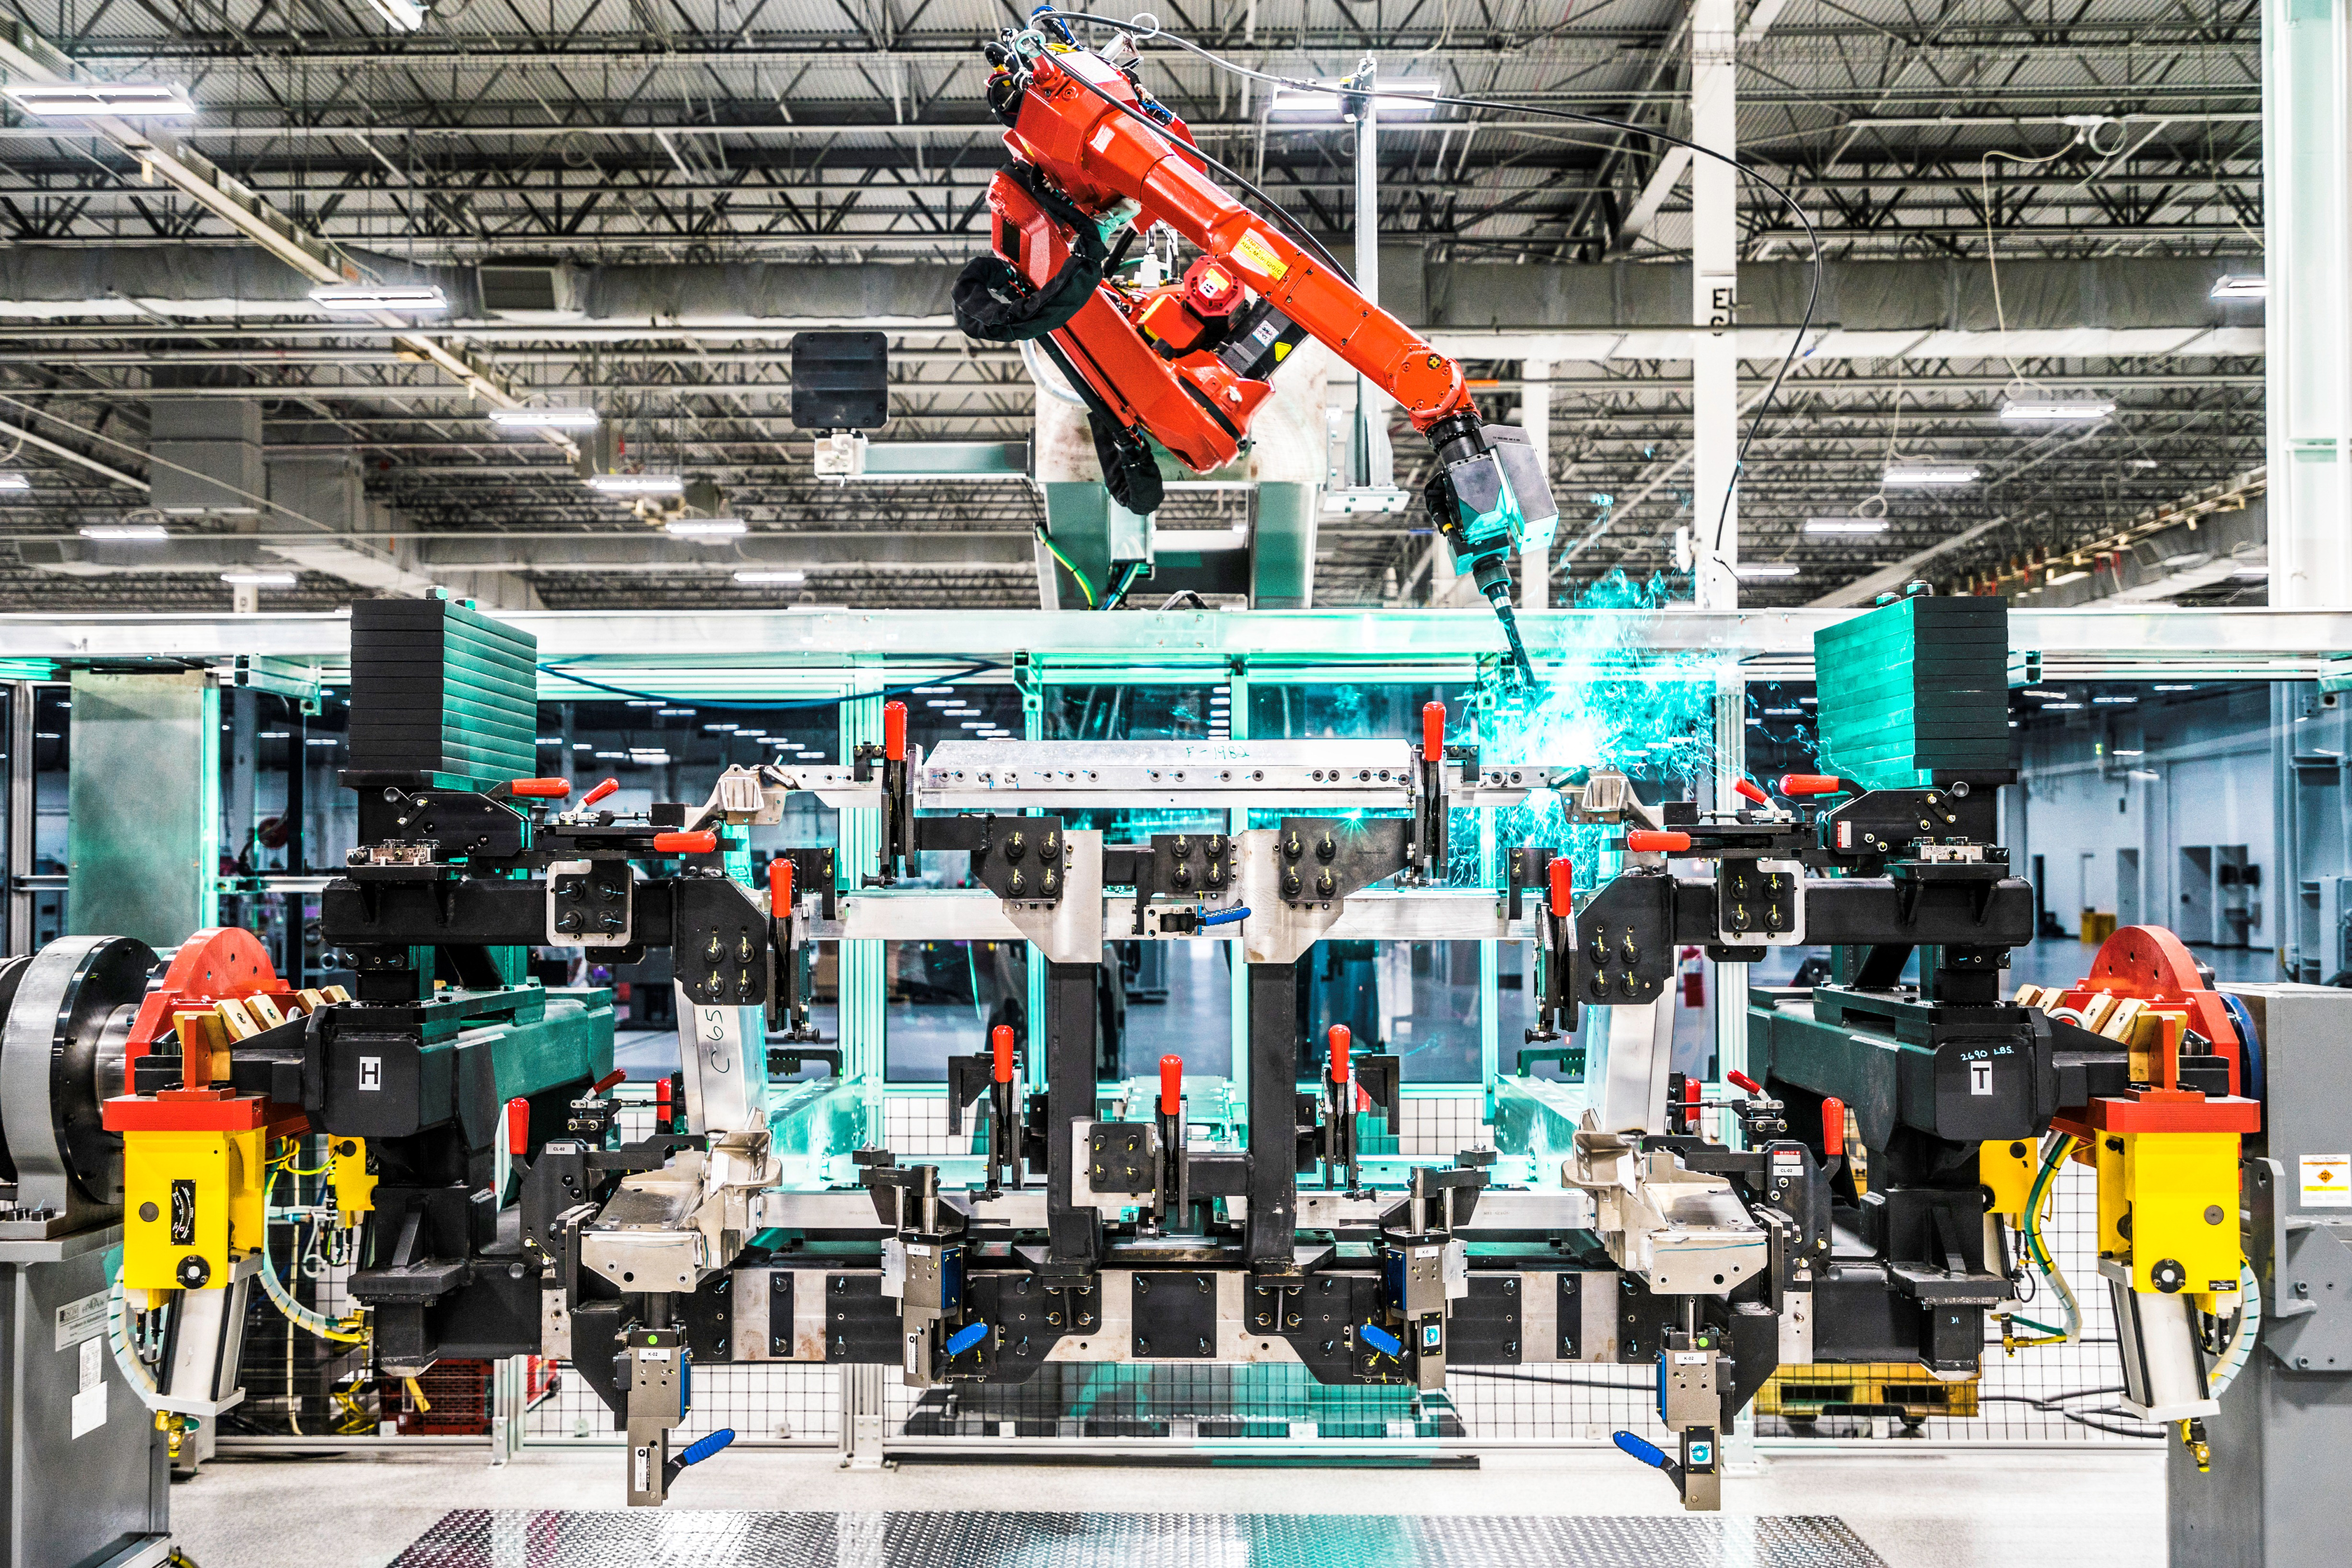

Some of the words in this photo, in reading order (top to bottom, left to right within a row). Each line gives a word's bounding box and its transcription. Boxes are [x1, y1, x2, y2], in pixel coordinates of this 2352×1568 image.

[1241, 242, 1253, 252] ARC
[1713, 288, 1728, 309] E
[1961, 1050, 1988, 1061] 2690
[361, 1063, 379, 1084] H
[1972, 1067, 1990, 1089] T
